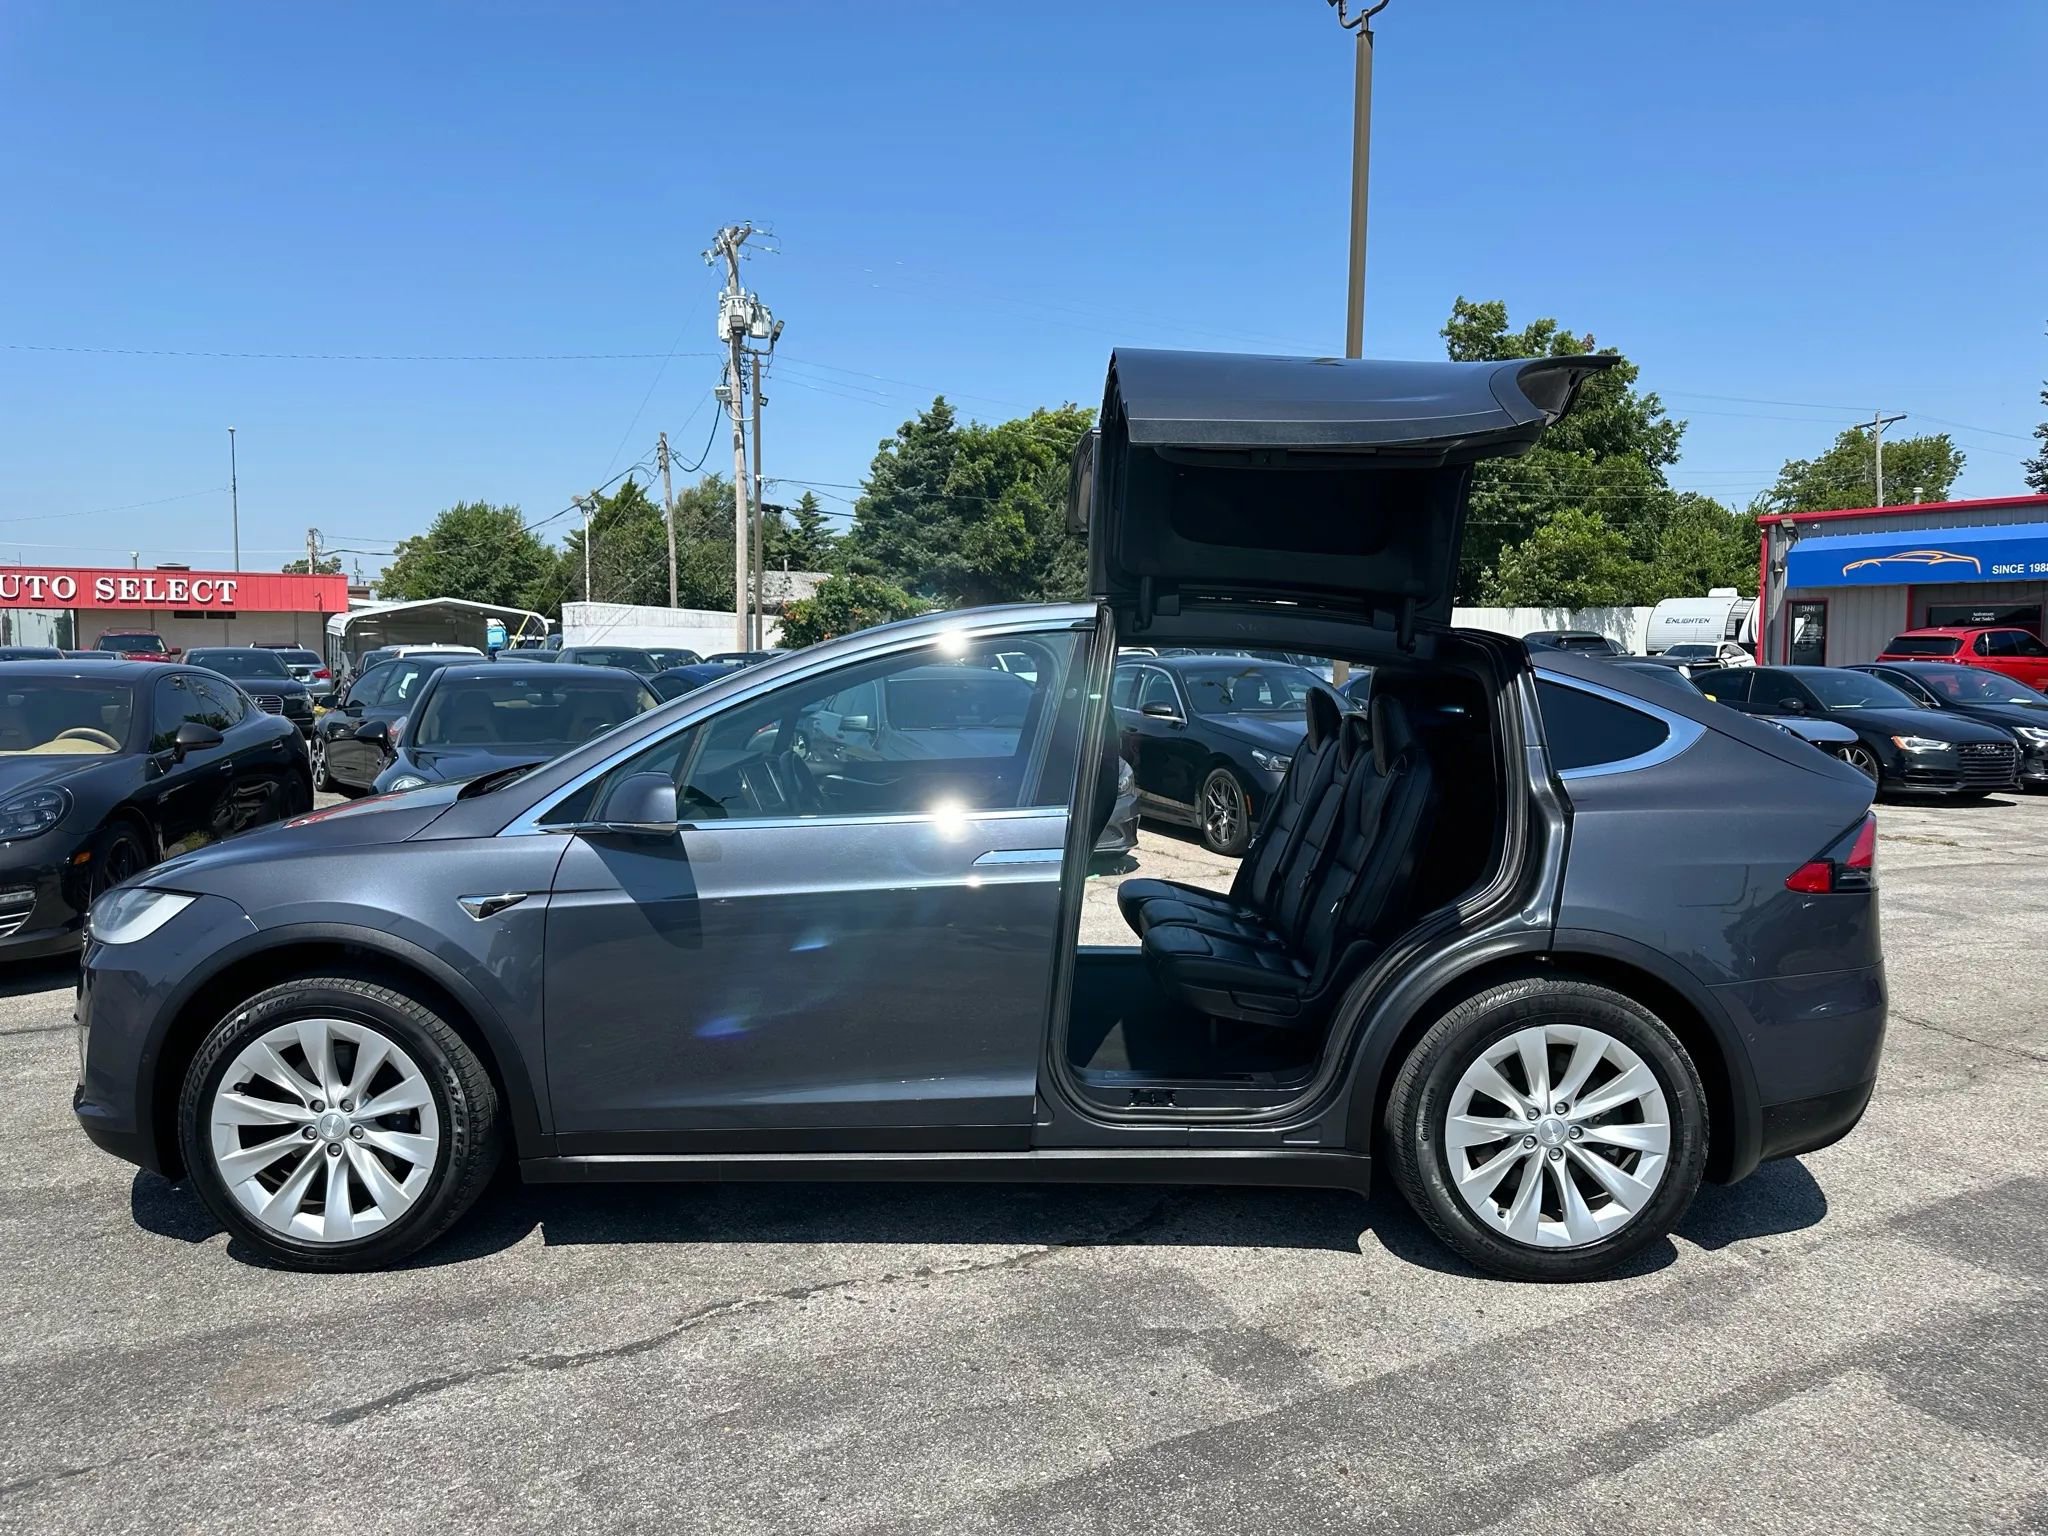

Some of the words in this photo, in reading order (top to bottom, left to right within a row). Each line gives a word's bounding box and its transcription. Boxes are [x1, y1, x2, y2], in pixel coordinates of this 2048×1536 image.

[1992, 564, 2025, 575] SINCE
[95, 577, 237, 603] SELECT
[1665, 616, 1711, 624] ENLIGHTEN
[1420, 1093, 1435, 1142] Continental
